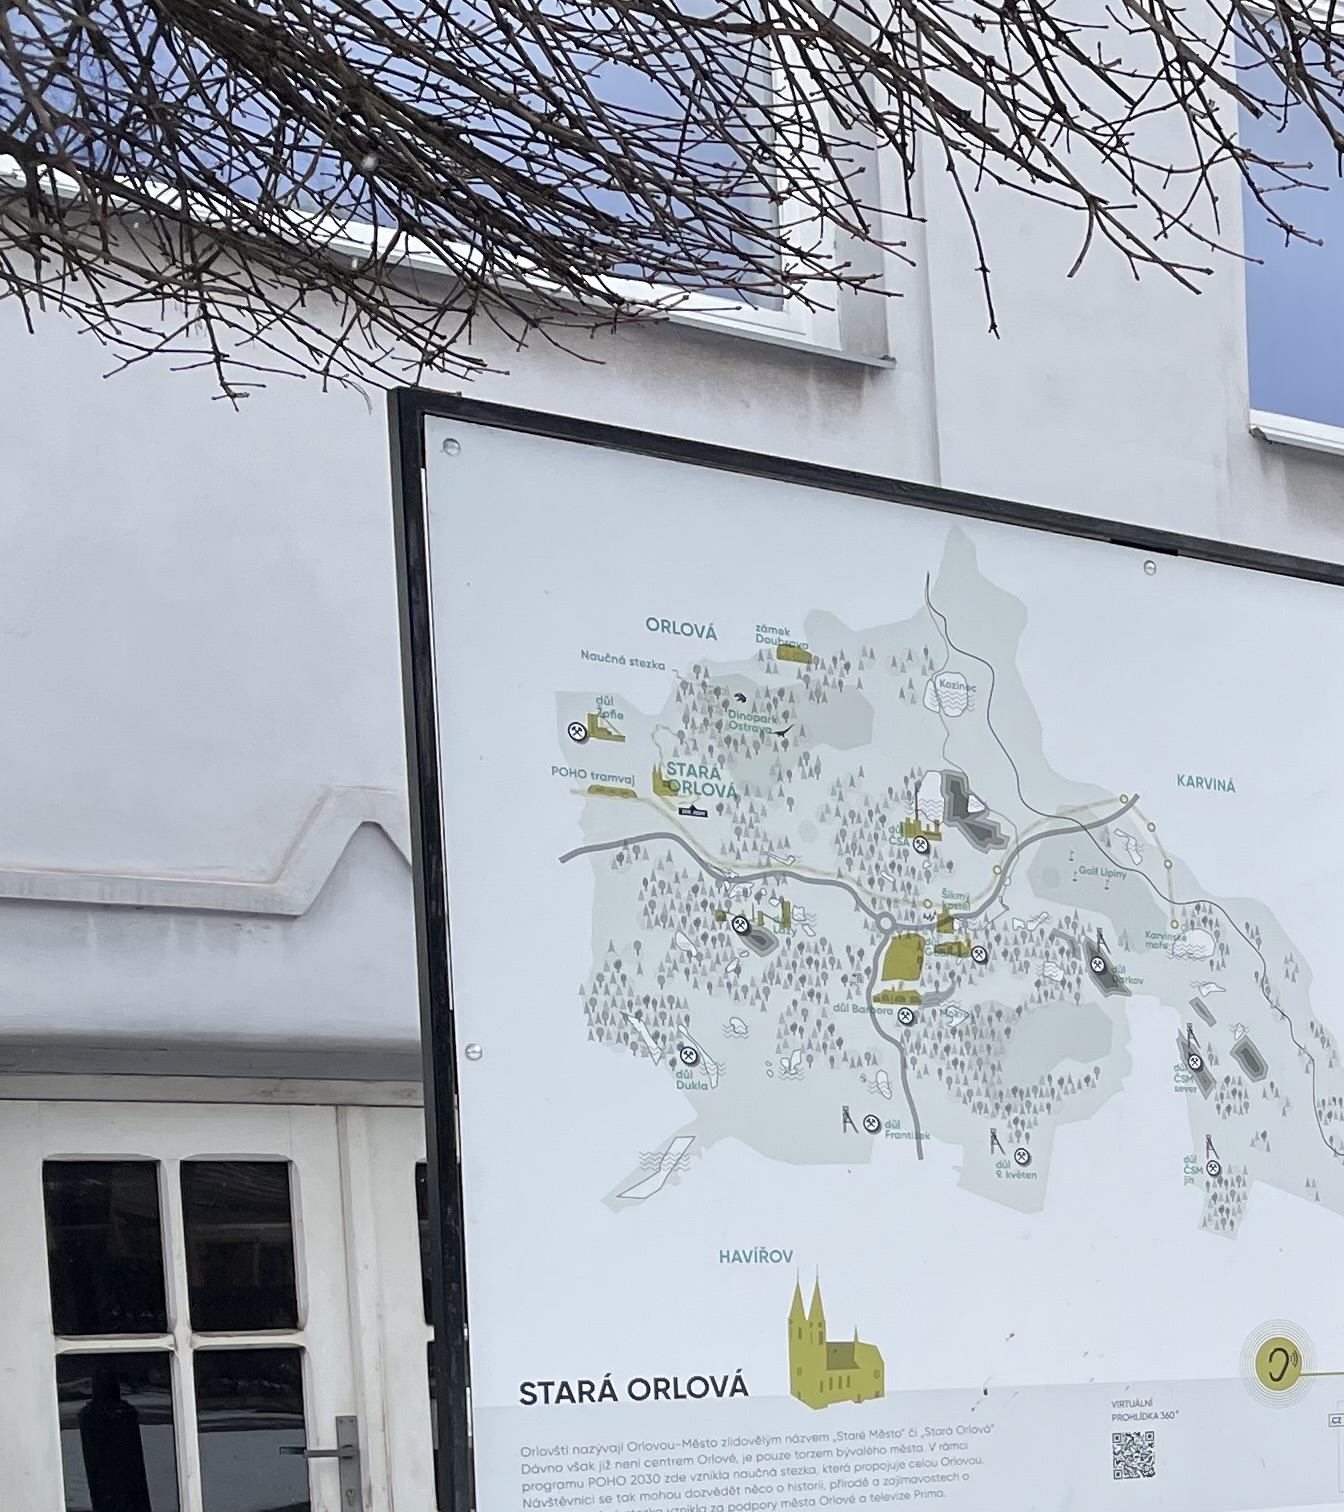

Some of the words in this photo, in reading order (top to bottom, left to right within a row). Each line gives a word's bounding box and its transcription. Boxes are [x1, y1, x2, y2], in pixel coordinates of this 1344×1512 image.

[646, 617, 717, 641] ORLOVÁ
[755, 624, 791, 637] zámek
[580, 649, 626, 665] Naučná
[629, 658, 666, 670] stezka
[728, 709, 778, 725] Dinopark
[551, 766, 587, 779] POHO
[590, 771, 635, 786] tramvaj
[666, 761, 721, 780] STARÁ
[668, 779, 738, 798] ORLOVÁ
[1176, 773, 1236, 793] KARVINÁ
[1079, 865, 1097, 877] Golf
[675, 1068, 693, 1079] důl
[676, 1080, 708, 1091] Dukla
[719, 1246, 794, 1264] HAVÍŘOV
[519, 1373, 618, 1405] STARÁ
[627, 1369, 749, 1400] ORLOVÁ
[1111, 1398, 1153, 1408] VIRTUÁLNÍ
[720, 1435, 782, 1447] zlidovělým
[784, 1433, 830, 1443] názvem
[520, 1463, 564, 1475] Dávno
[566, 1461, 596, 1472] však
[643, 1457, 694, 1468] centrem
[696, 1453, 739, 1465] Orlové,
[741, 1454, 753, 1465] je
[755, 1452, 792, 1463] pouze
[794, 1449, 834, 1459] torzem
[835, 1446, 888, 1458] bývalého
[928, 1441, 937, 1452] V
[938, 1442, 968, 1451] rámci
[521, 1480, 584, 1493] programu
[587, 1475, 627, 1487] POHO
[629, 1473, 661, 1485] 2030
[663, 1473, 686, 1483] zde
[689, 1470, 730, 1482] vznikla
[732, 1467, 778, 1478] naučná
[780, 1465, 819, 1476] stezka,
[822, 1463, 851, 1473] která
[853, 1461, 906, 1473] propojuje
[908, 1458, 938, 1468] celou
[940, 1456, 984, 1466] Orlovou.
[522, 1496, 595, 1508] Návštěvníci
[598, 1495, 613, 1504] se
[615, 1492, 636, 1503] tak
[639, 1490, 682, 1501] mohou
[684, 1485, 741, 1498] dozvědět
[744, 1484, 774, 1494] něco
[776, 1484, 784, 1493] o
[871, 1478, 880, 1487] a
[961, 1473, 970, 1481] o
[710, 1504, 724, 1512] za
[727, 1501, 778, 1512] podpory
[780, 1497, 816, 1508] města
[818, 1494, 856, 1506] Orlové
[858, 1495, 867, 1503] a
[869, 1492, 911, 1502] televize
[913, 1489, 946, 1499] Prima.
